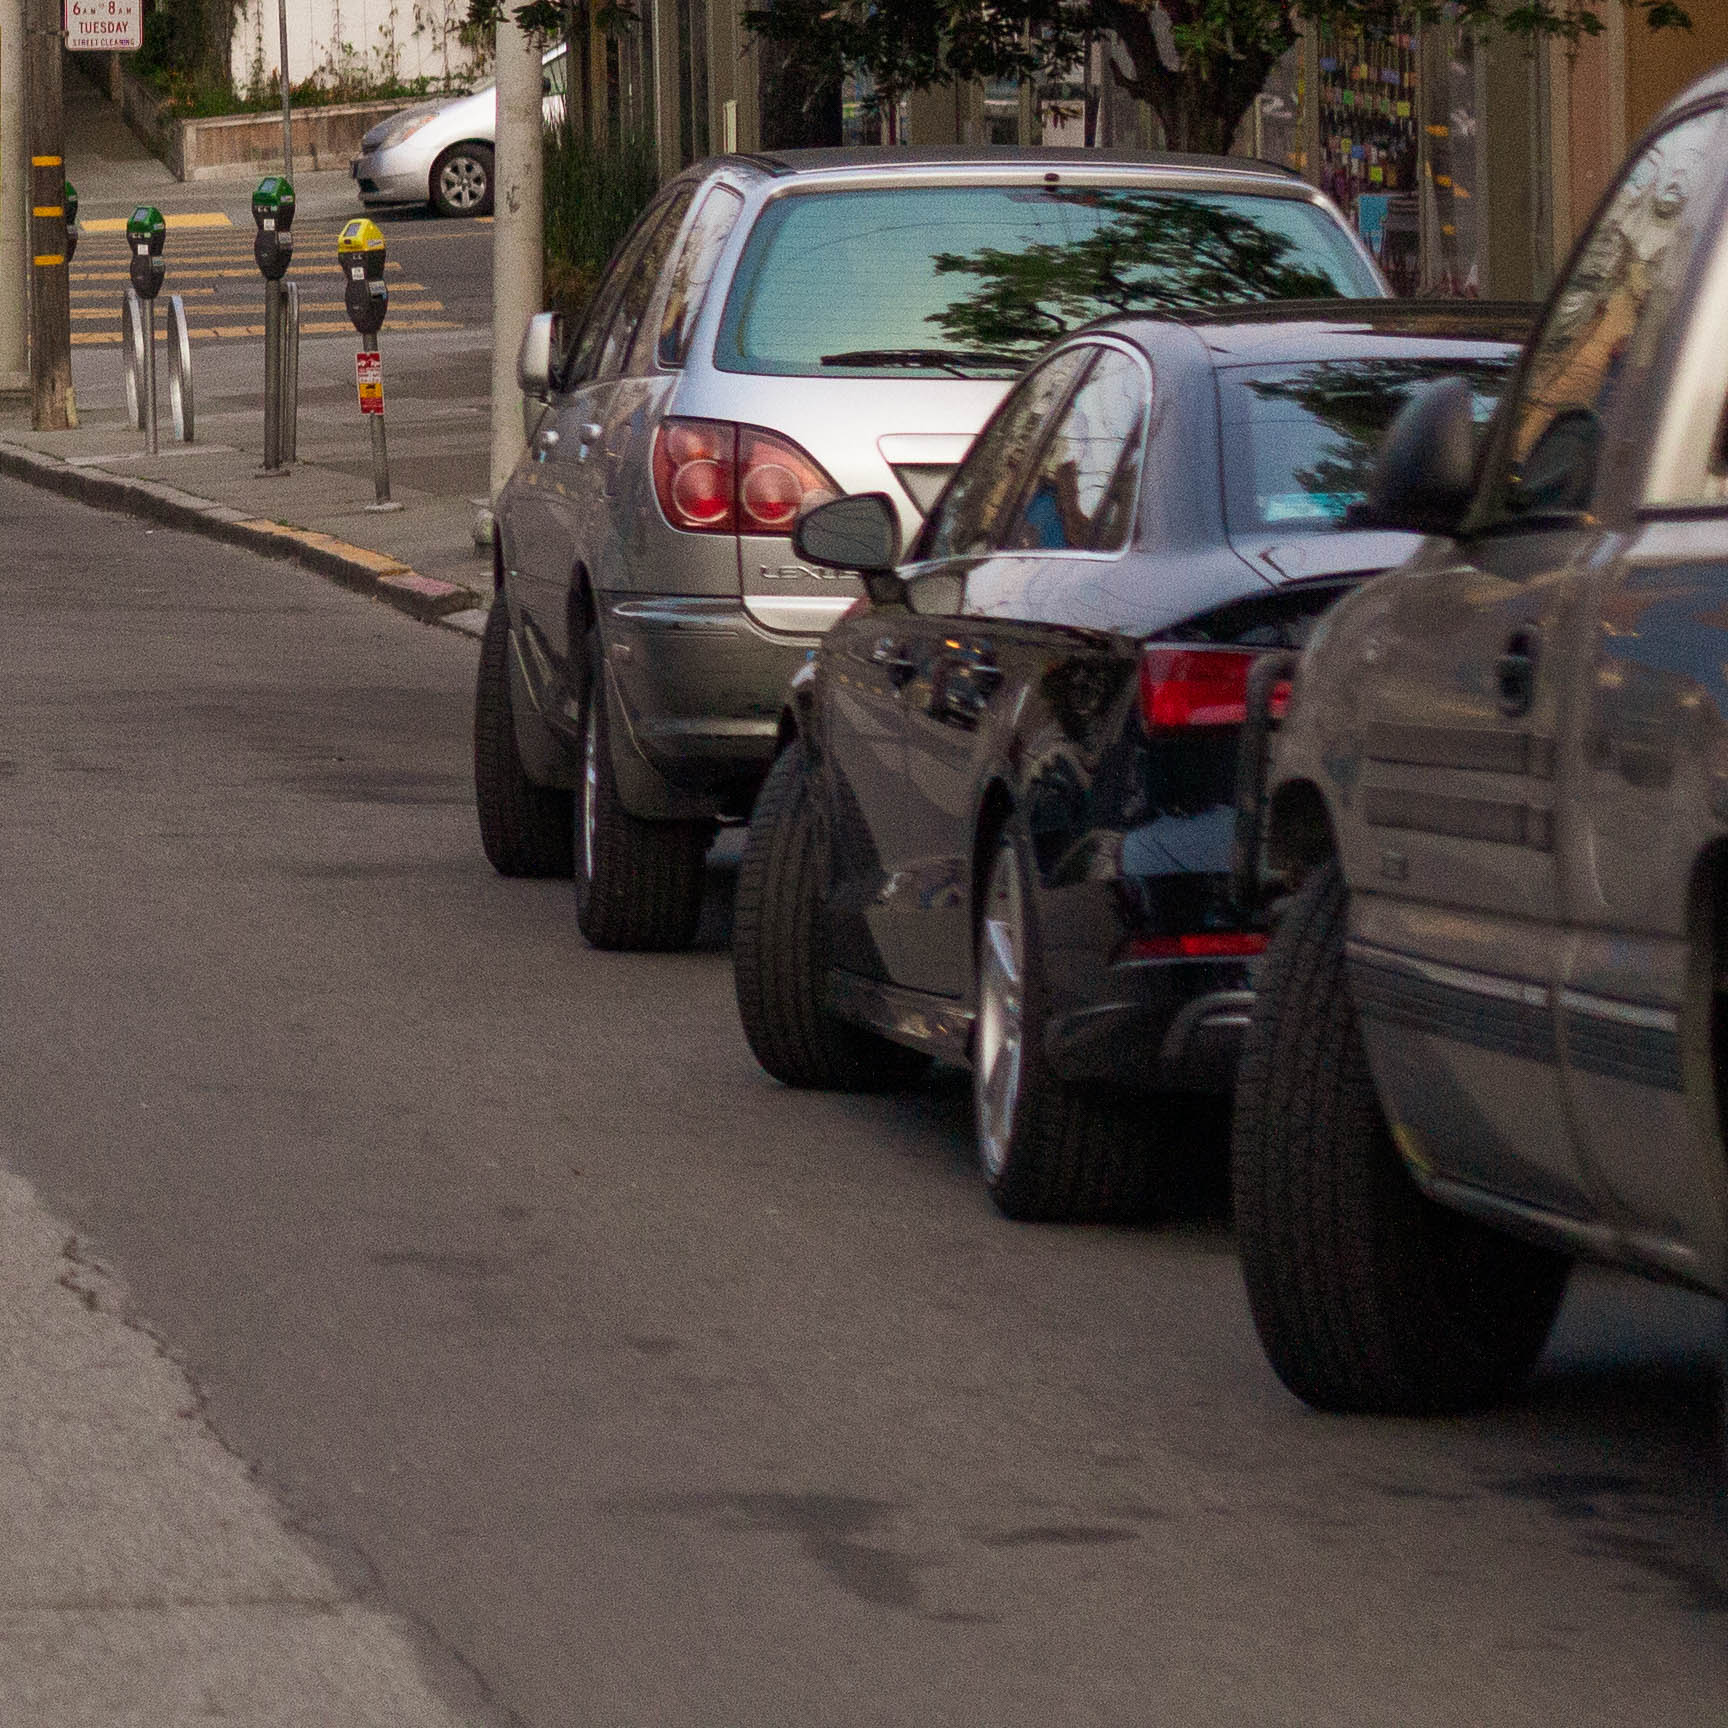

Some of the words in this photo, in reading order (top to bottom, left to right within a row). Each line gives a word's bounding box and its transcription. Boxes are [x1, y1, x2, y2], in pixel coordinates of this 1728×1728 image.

[73, 1, 81, 16] 6
[108, 0, 116, 16] 8
[79, 21, 129, 34] TUESDAY
[72, 38, 99, 47] STREET
[100, 38, 135, 47] CLEANING
